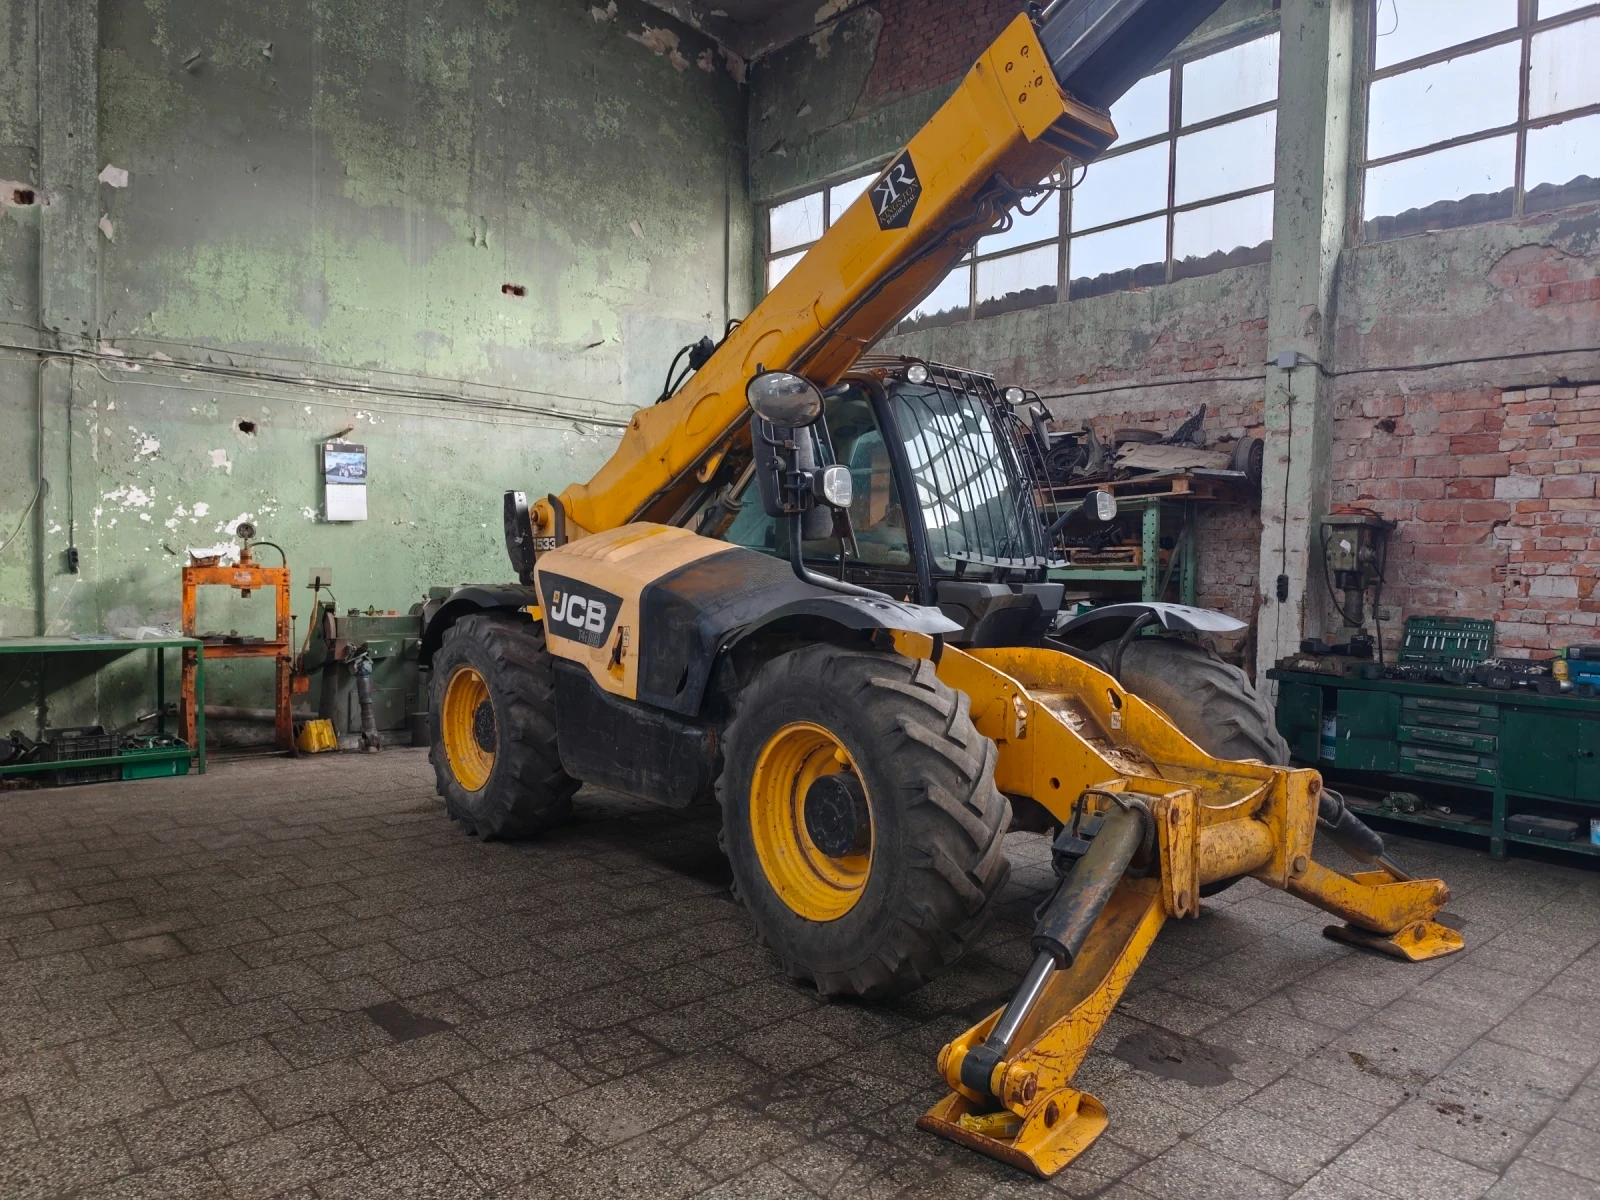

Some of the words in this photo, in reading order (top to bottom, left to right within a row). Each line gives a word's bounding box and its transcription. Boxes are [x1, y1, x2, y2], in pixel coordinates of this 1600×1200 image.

[879, 180, 919, 224] KINGSTON
[886, 195, 916, 225] RESIDENTIAL
[551, 592, 607, 634] JCB
